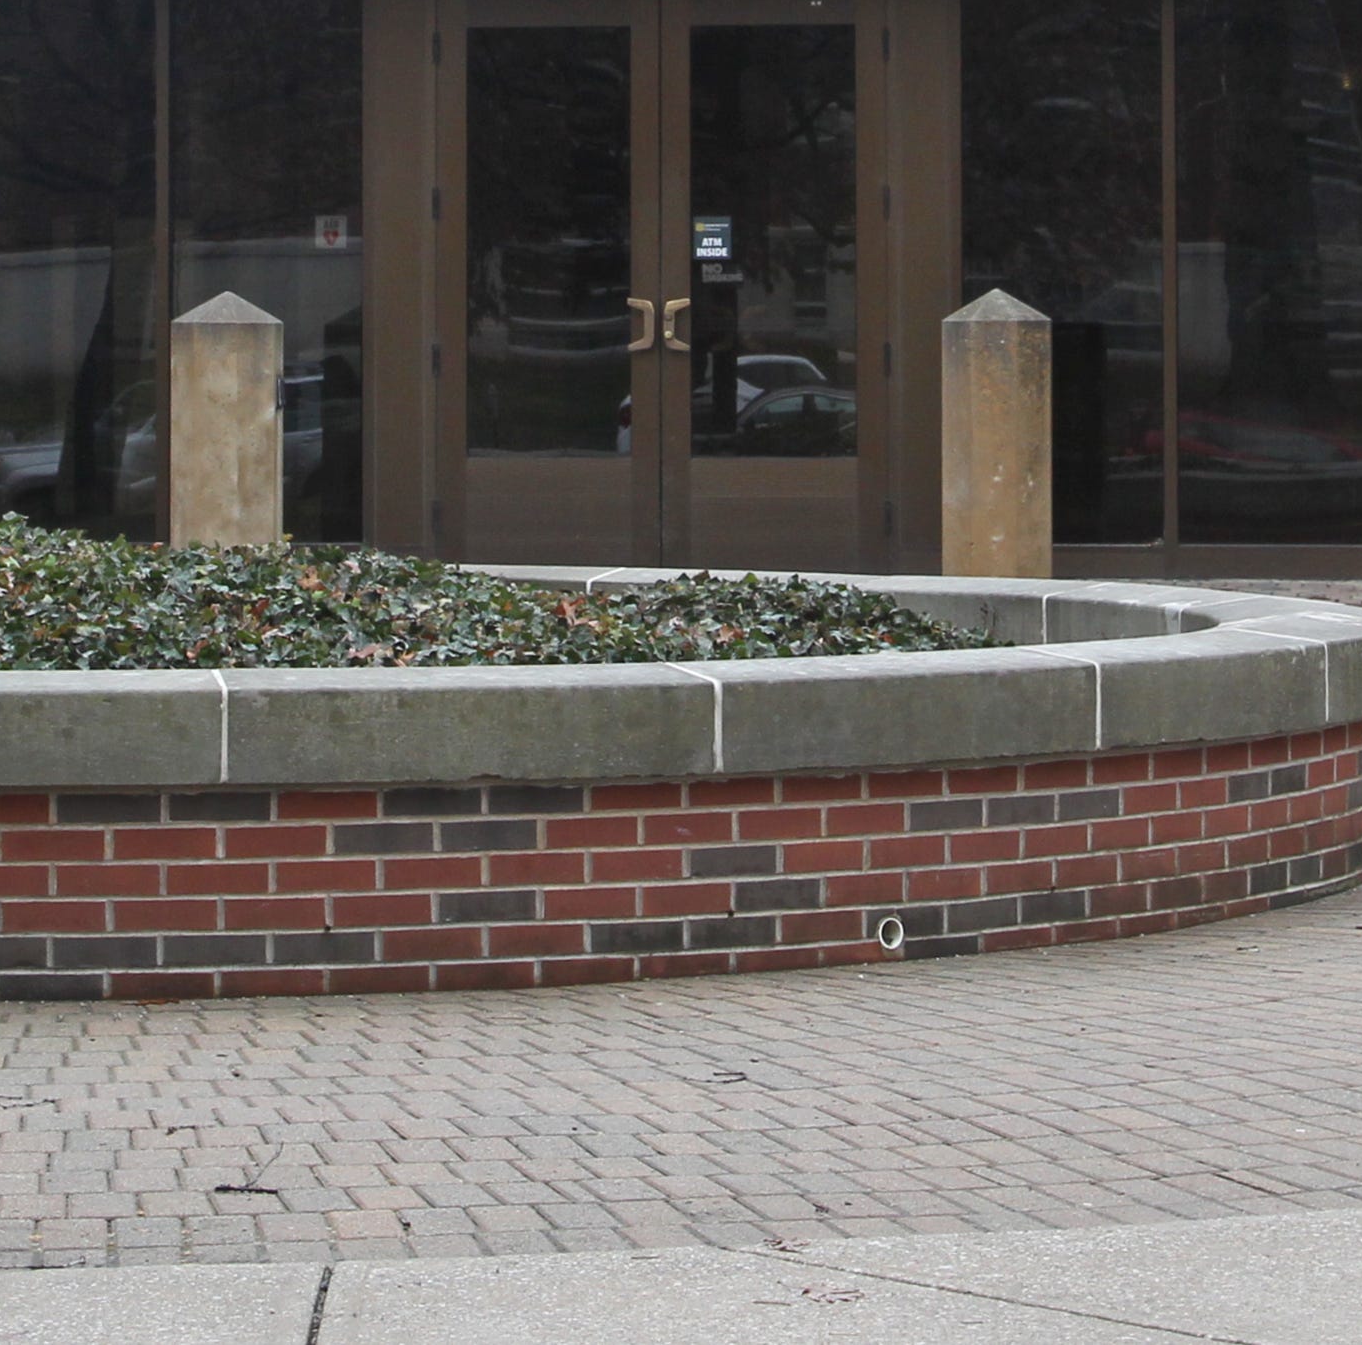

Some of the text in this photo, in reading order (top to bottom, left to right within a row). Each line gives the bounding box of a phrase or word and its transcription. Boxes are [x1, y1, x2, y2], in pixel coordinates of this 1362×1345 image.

[702, 238, 722, 247] ATM
[696, 247, 728, 257] INSIDE
[702, 263, 723, 273] NO
